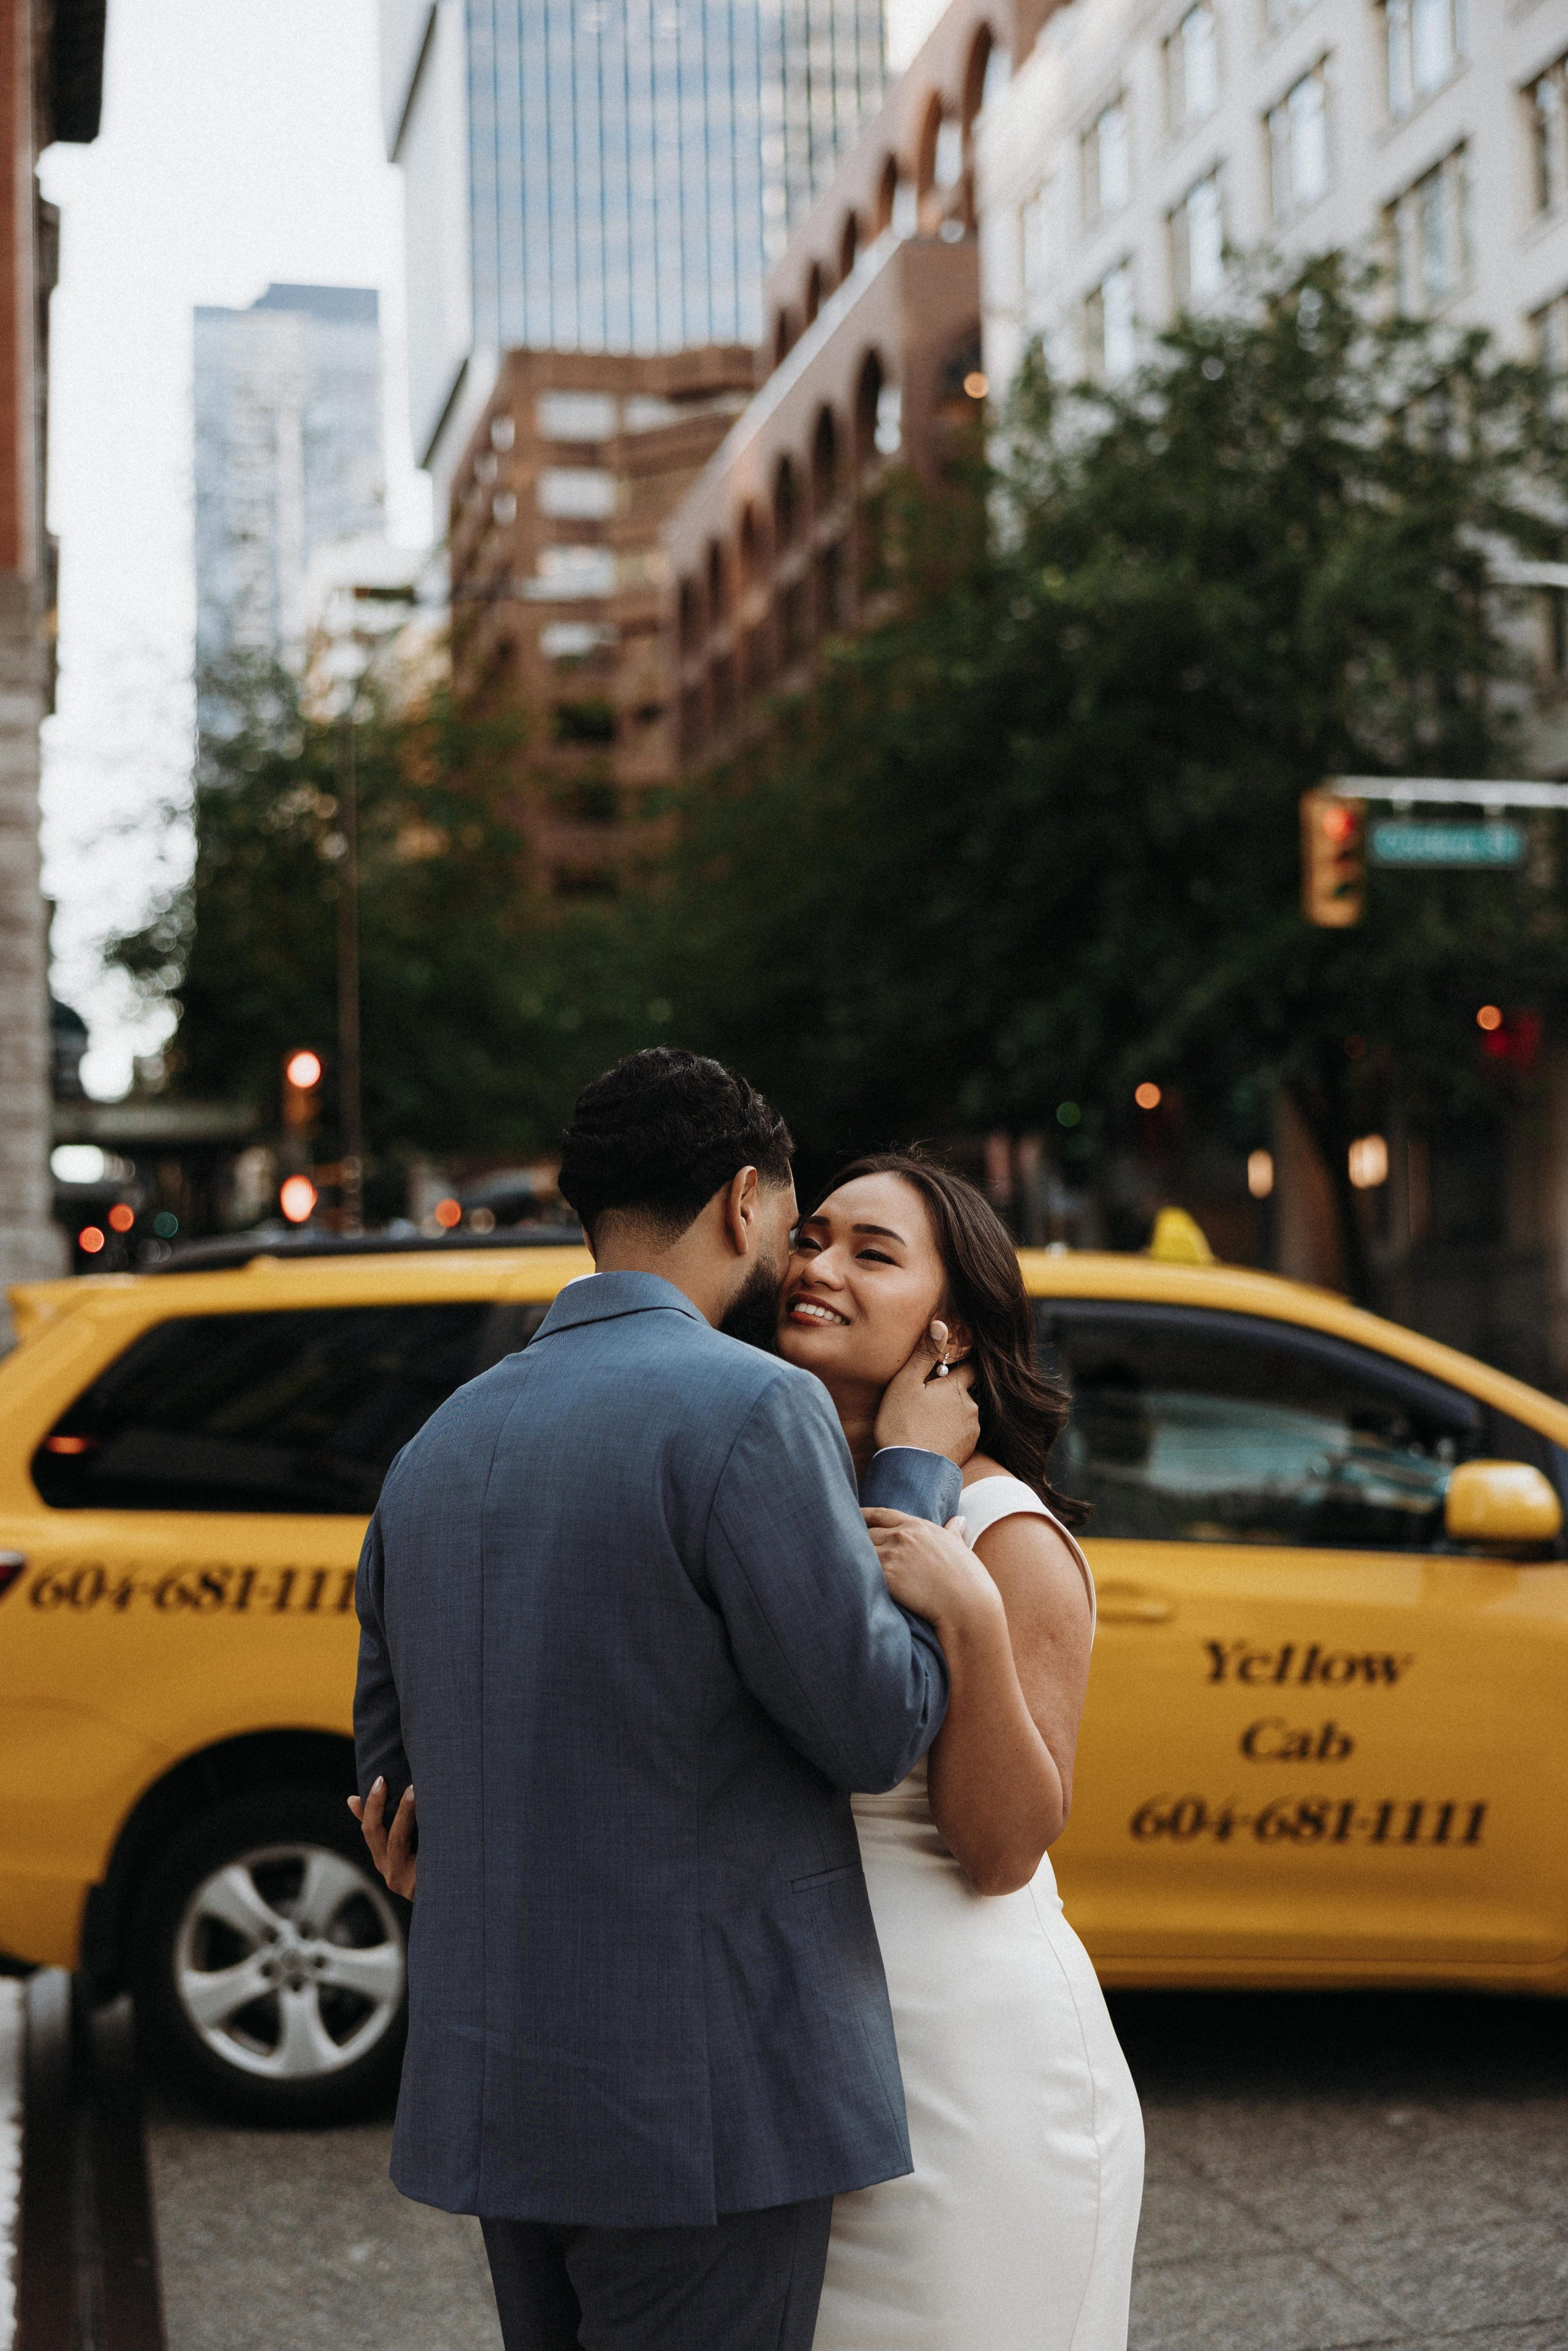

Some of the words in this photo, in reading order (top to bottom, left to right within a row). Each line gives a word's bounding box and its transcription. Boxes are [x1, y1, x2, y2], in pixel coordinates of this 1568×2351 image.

[29, 1561, 357, 1614] 604-681-111
[1204, 1639, 1414, 1686] Yellow
[1238, 1716, 1356, 1763] Cab
[1129, 1793, 1489, 1846] 604-681-1111
